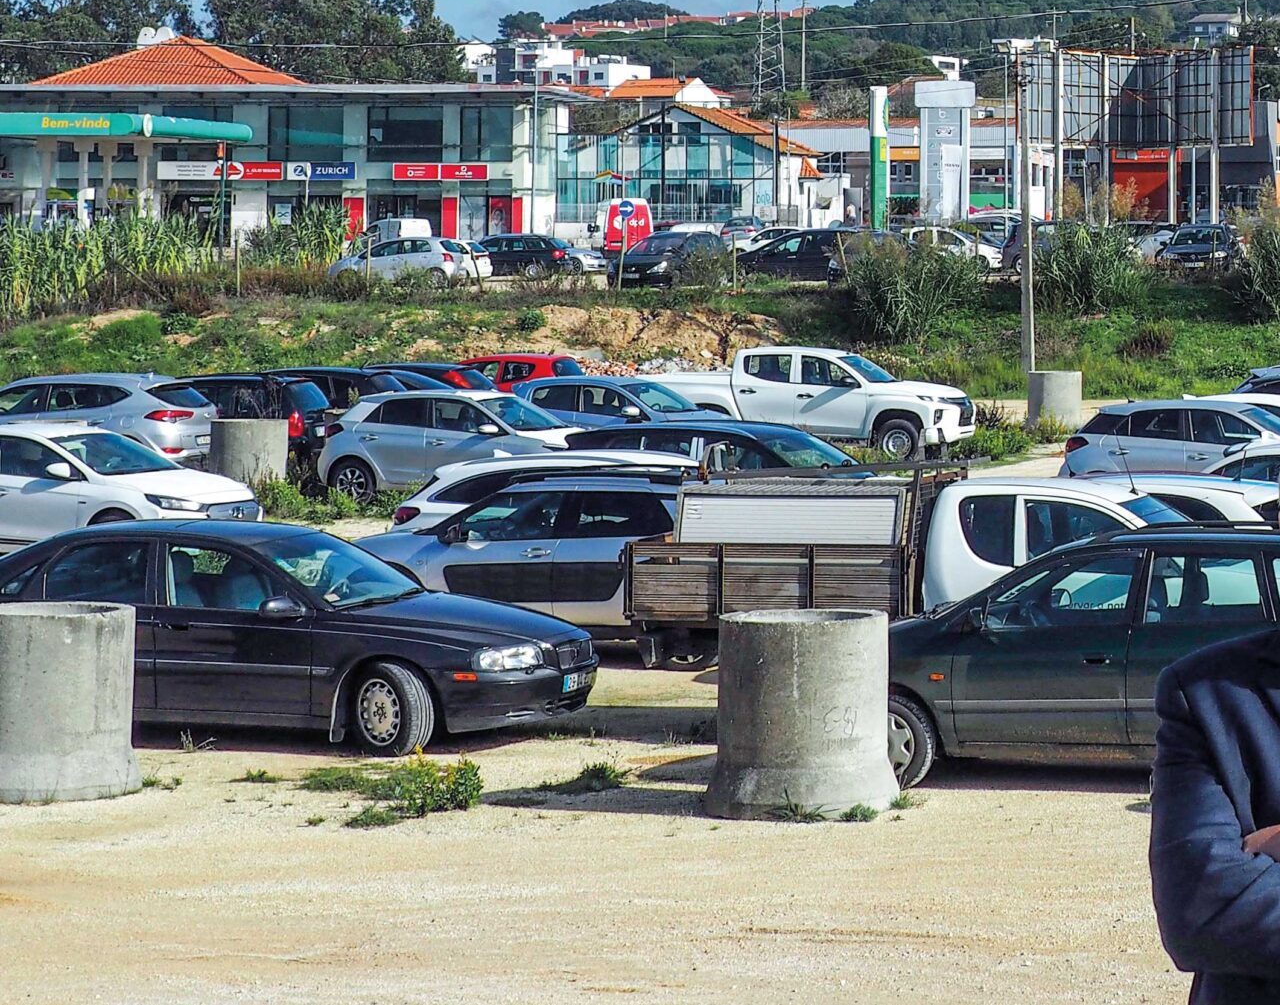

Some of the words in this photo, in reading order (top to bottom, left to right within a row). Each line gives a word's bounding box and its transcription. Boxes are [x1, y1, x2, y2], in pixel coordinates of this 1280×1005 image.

[41, 116, 111, 129] Bem-vindo
[315, 166, 349, 175] ZURICH
[628, 216, 645, 228] dpd
